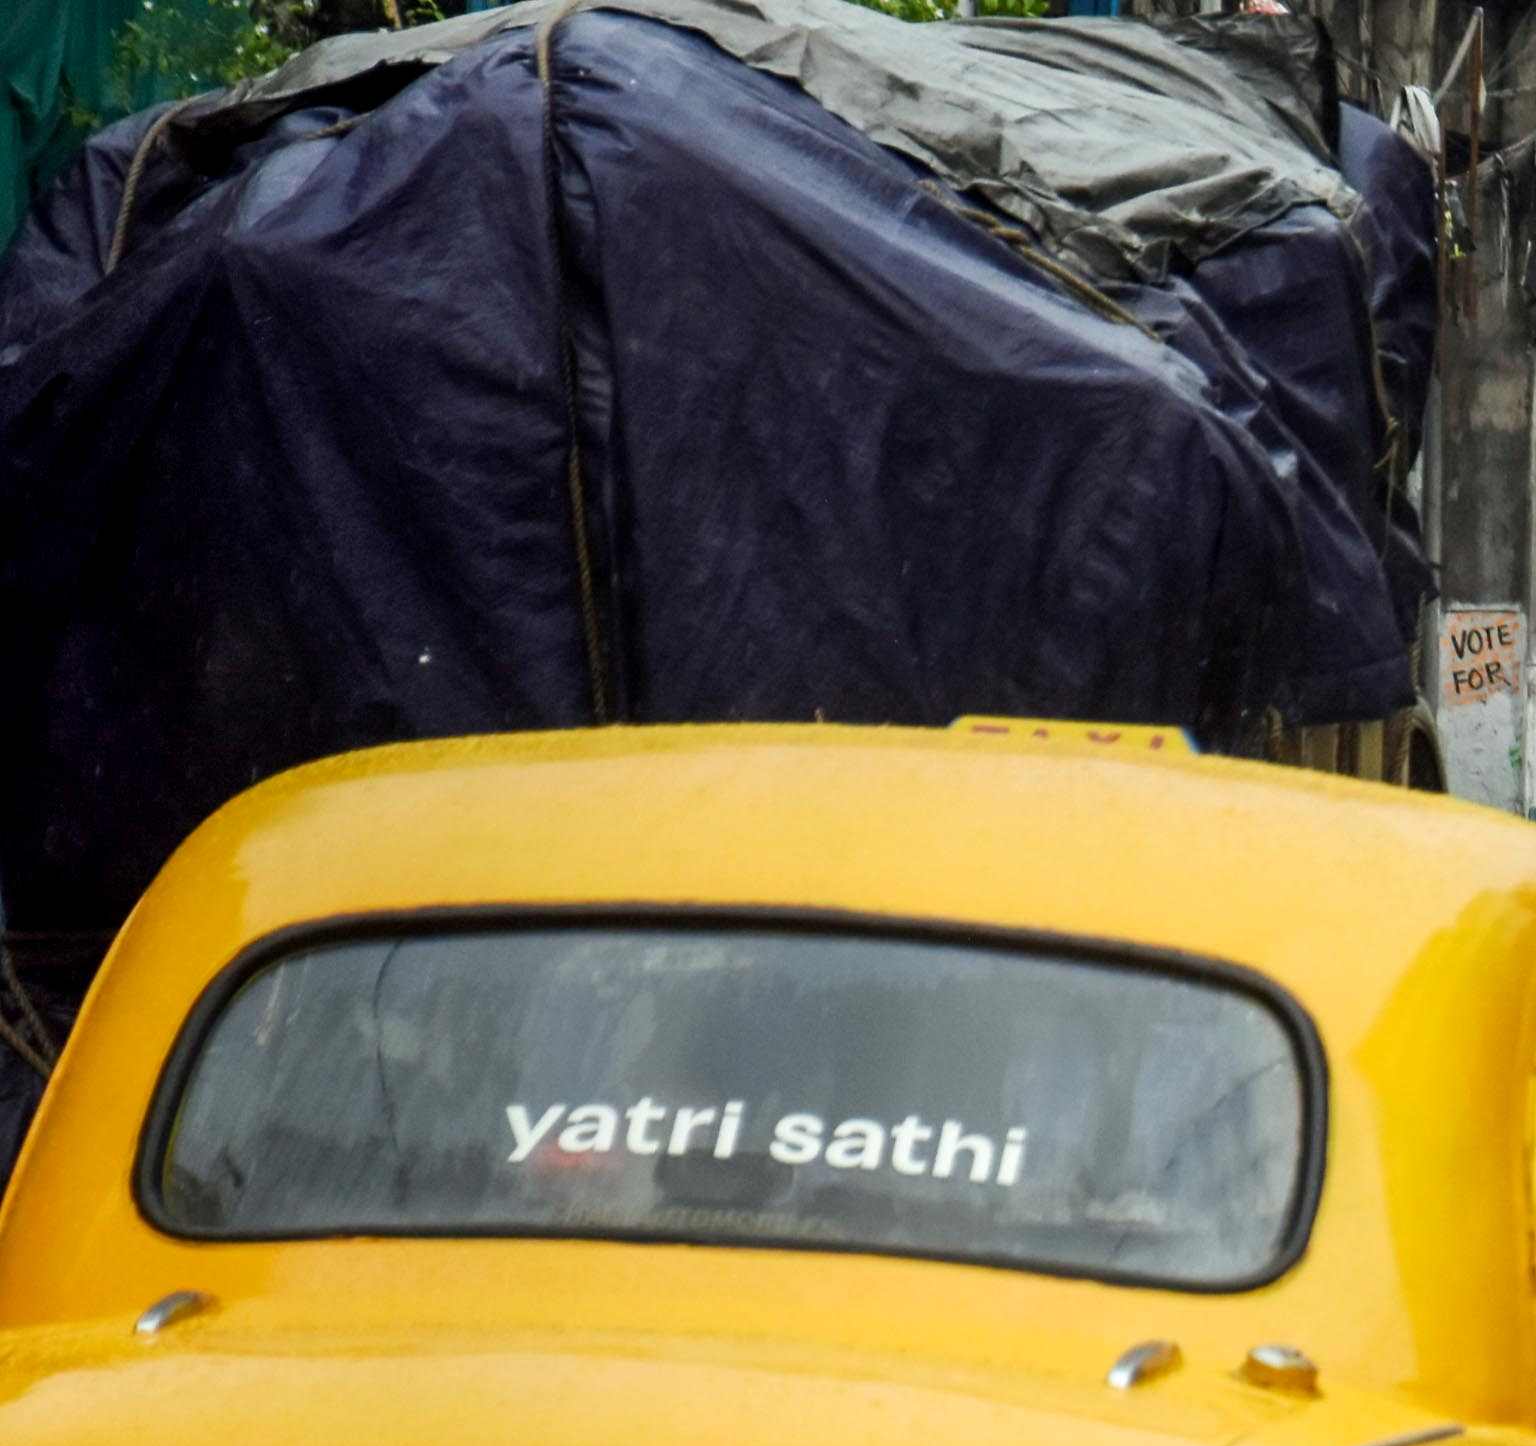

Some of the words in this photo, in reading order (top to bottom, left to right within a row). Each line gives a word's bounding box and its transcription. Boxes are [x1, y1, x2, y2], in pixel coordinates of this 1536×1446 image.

[1451, 624, 1513, 660] VOTE
[1453, 661, 1511, 694] FOR
[505, 1096, 745, 1163] yatri
[768, 1111, 1029, 1187] sathi
